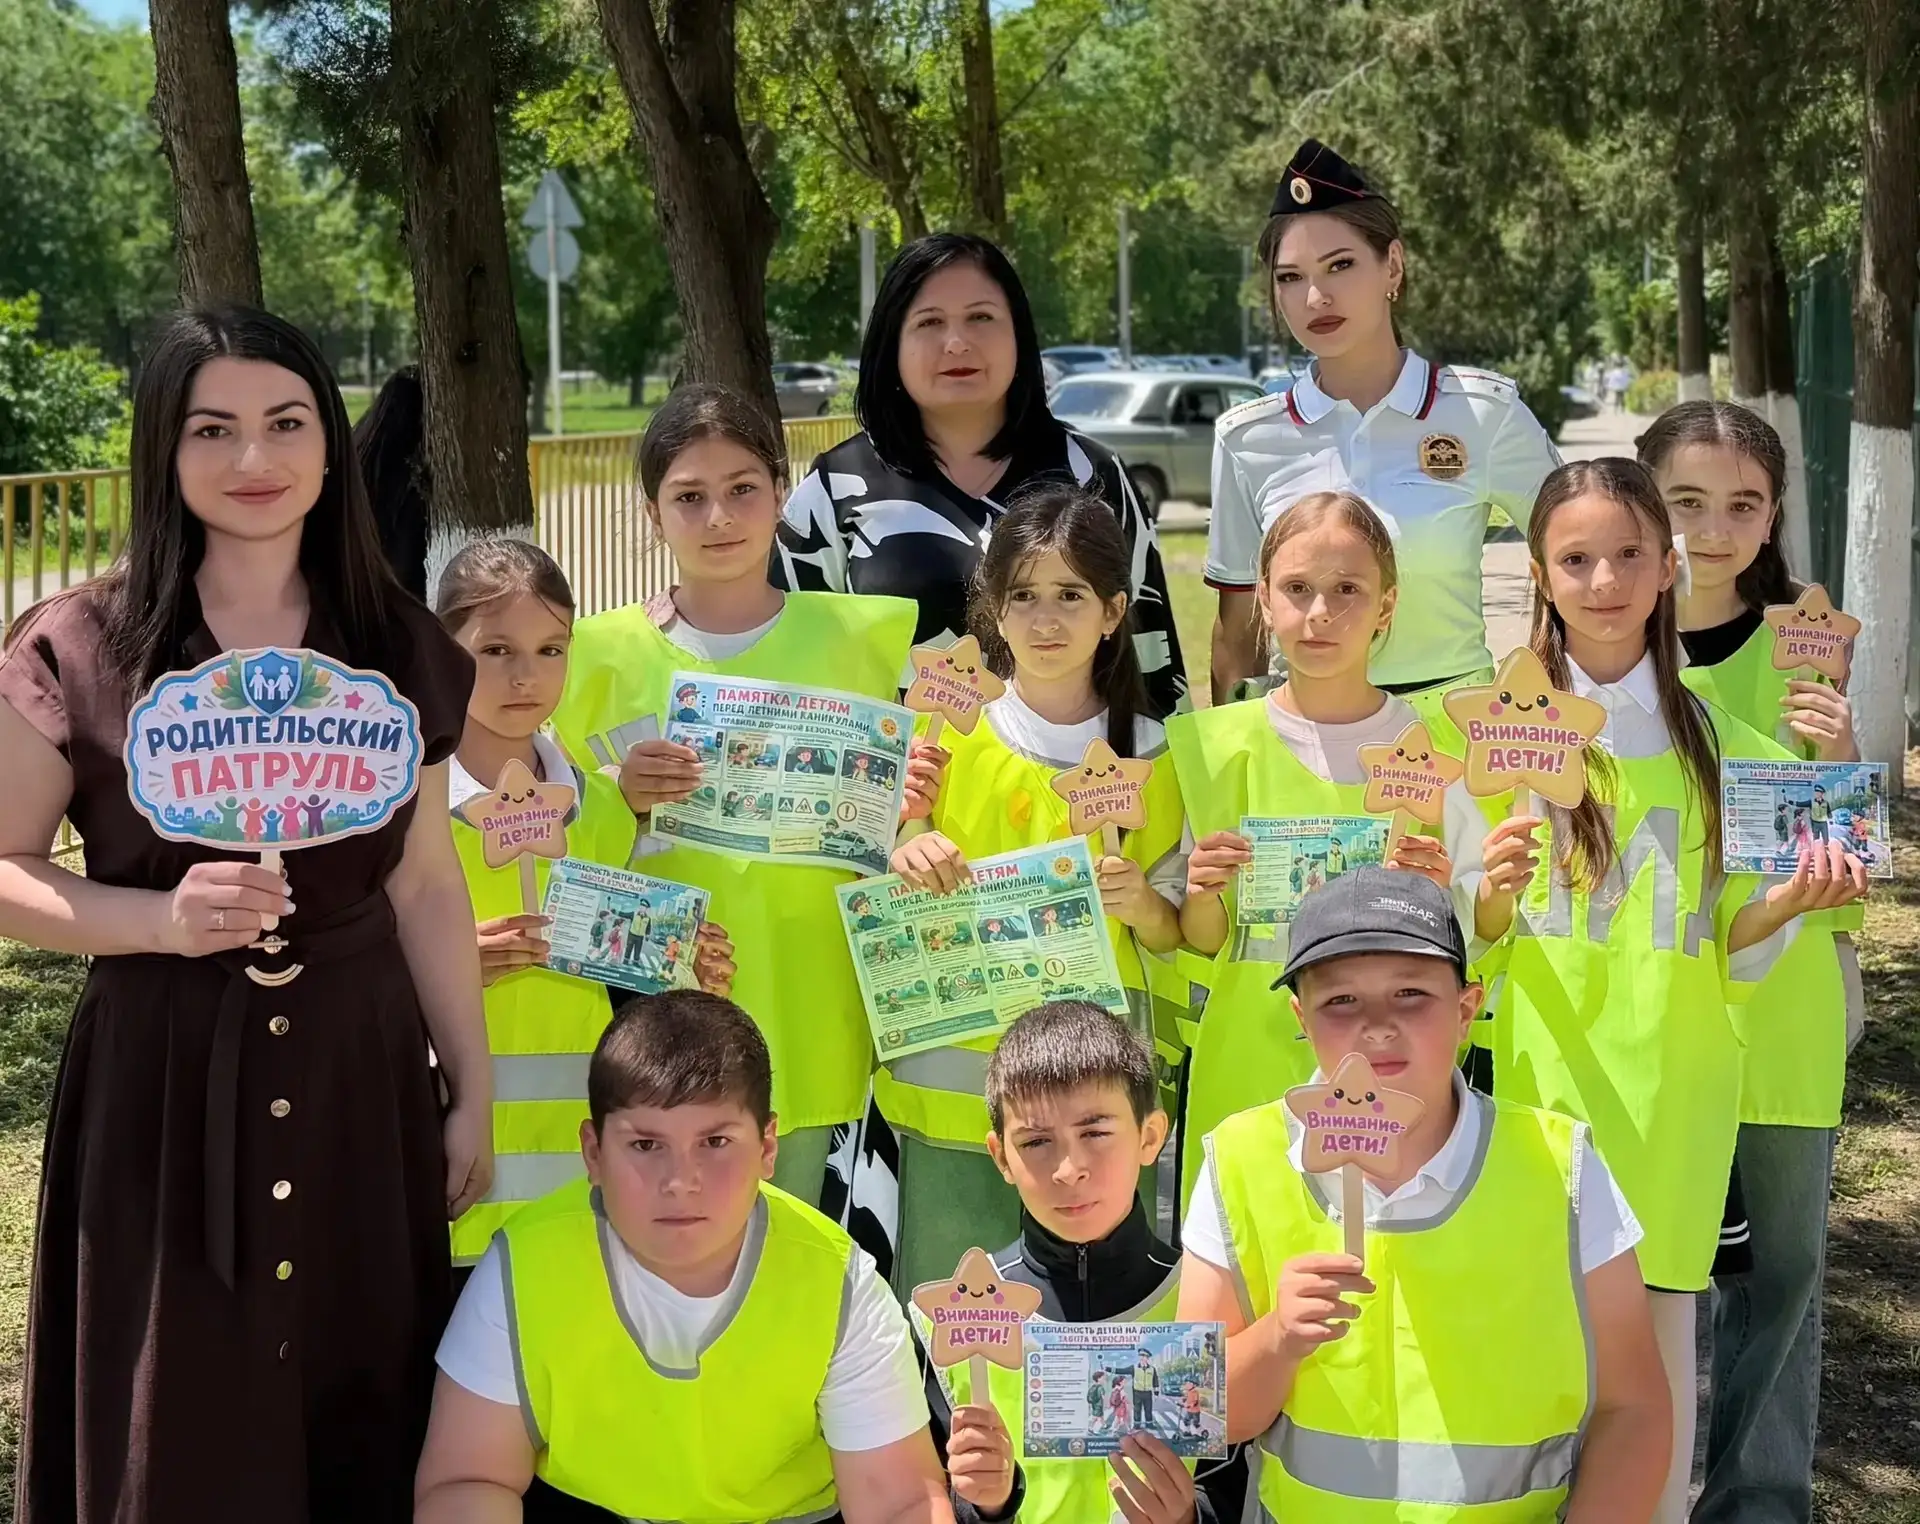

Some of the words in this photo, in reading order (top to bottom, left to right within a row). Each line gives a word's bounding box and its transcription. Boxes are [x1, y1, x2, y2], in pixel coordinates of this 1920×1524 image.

[1786, 642, 1834, 659] дети!
[920, 666, 987, 703] Внимание-
[716, 688, 791, 707] ПАМЯТКА
[796, 695, 850, 715] ДЕТЯМ
[923, 686, 972, 714] дети!
[713, 703, 744, 714] ПЕРЕД
[749, 705, 797, 719] ЛЕТНИМИ
[800, 711, 870, 733] КАНИКУЛАМИ
[720, 717, 757, 728] ПРАВИЛА
[805, 724, 864, 741] БЕЗОПАСНОСТИ
[145, 715, 403, 757] РОДИТЕЛЬСКИЙ
[1468, 720, 1586, 746] Внимание-
[1486, 748, 1566, 775] дети!
[171, 751, 377, 799] ПАТРУЛЬ
[1372, 764, 1448, 787] Внимание-
[1069, 781, 1141, 804] Внимание-
[1380, 784, 1433, 803] дети!
[1083, 795, 1131, 820] дети!
[482, 808, 563, 832] Внимание-
[499, 823, 551, 849] дети!
[974, 863, 1019, 883] ЕТЯМ
[889, 893, 923, 910] ПЕРЕД
[973, 874, 1044, 895] КАНИКУЛАМИ
[903, 905, 939, 918] ПРАВИЛА
[1306, 1111, 1406, 1134] Внимание-
[1322, 1134, 1388, 1155] дети!
[934, 1307, 1025, 1324] Внимание-
[949, 1326, 1010, 1347] дети!
[1031, 1325, 1094, 1334] БЕЗОПАСНОСТЬ
[1096, 1325, 1123, 1335] ДЕТЕЙ
[1125, 1326, 1137, 1334] НА
[1139, 1326, 1172, 1334] ДОРОГЕ
